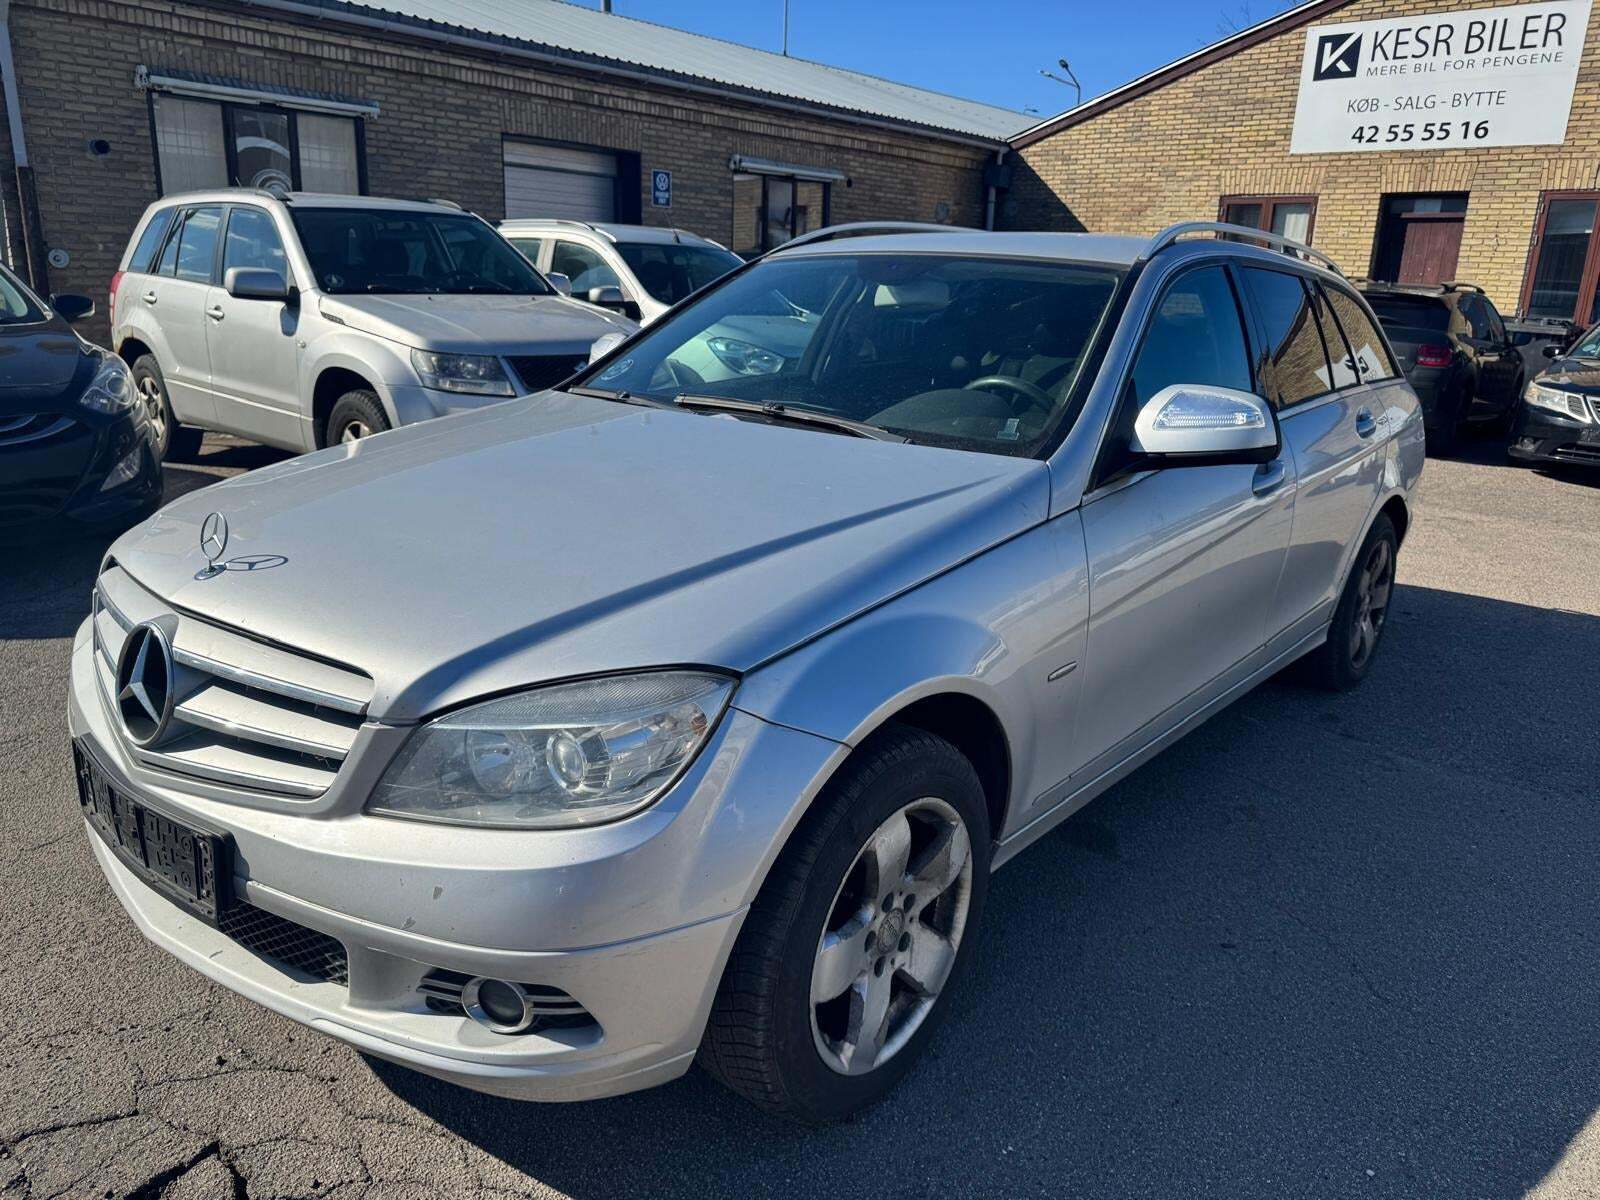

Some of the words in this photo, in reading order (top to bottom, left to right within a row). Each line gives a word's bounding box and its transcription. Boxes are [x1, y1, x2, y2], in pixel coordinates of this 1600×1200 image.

[1370, 23, 1455, 62] KESR
[1464, 12, 1567, 55] BILER
[1366, 64, 1407, 77] MERE
[1413, 61, 1436, 73] BIL
[1443, 59, 1475, 71] FOR
[1482, 51, 1564, 68] PENGENE
[1346, 98, 1379, 113] KØB
[1394, 94, 1436, 111] SALG
[1451, 90, 1507, 108] BYTTE
[1351, 125, 1379, 144] 42
[1385, 123, 1415, 142] 55
[1421, 121, 1451, 141] 55
[1461, 120, 1489, 140] 16
